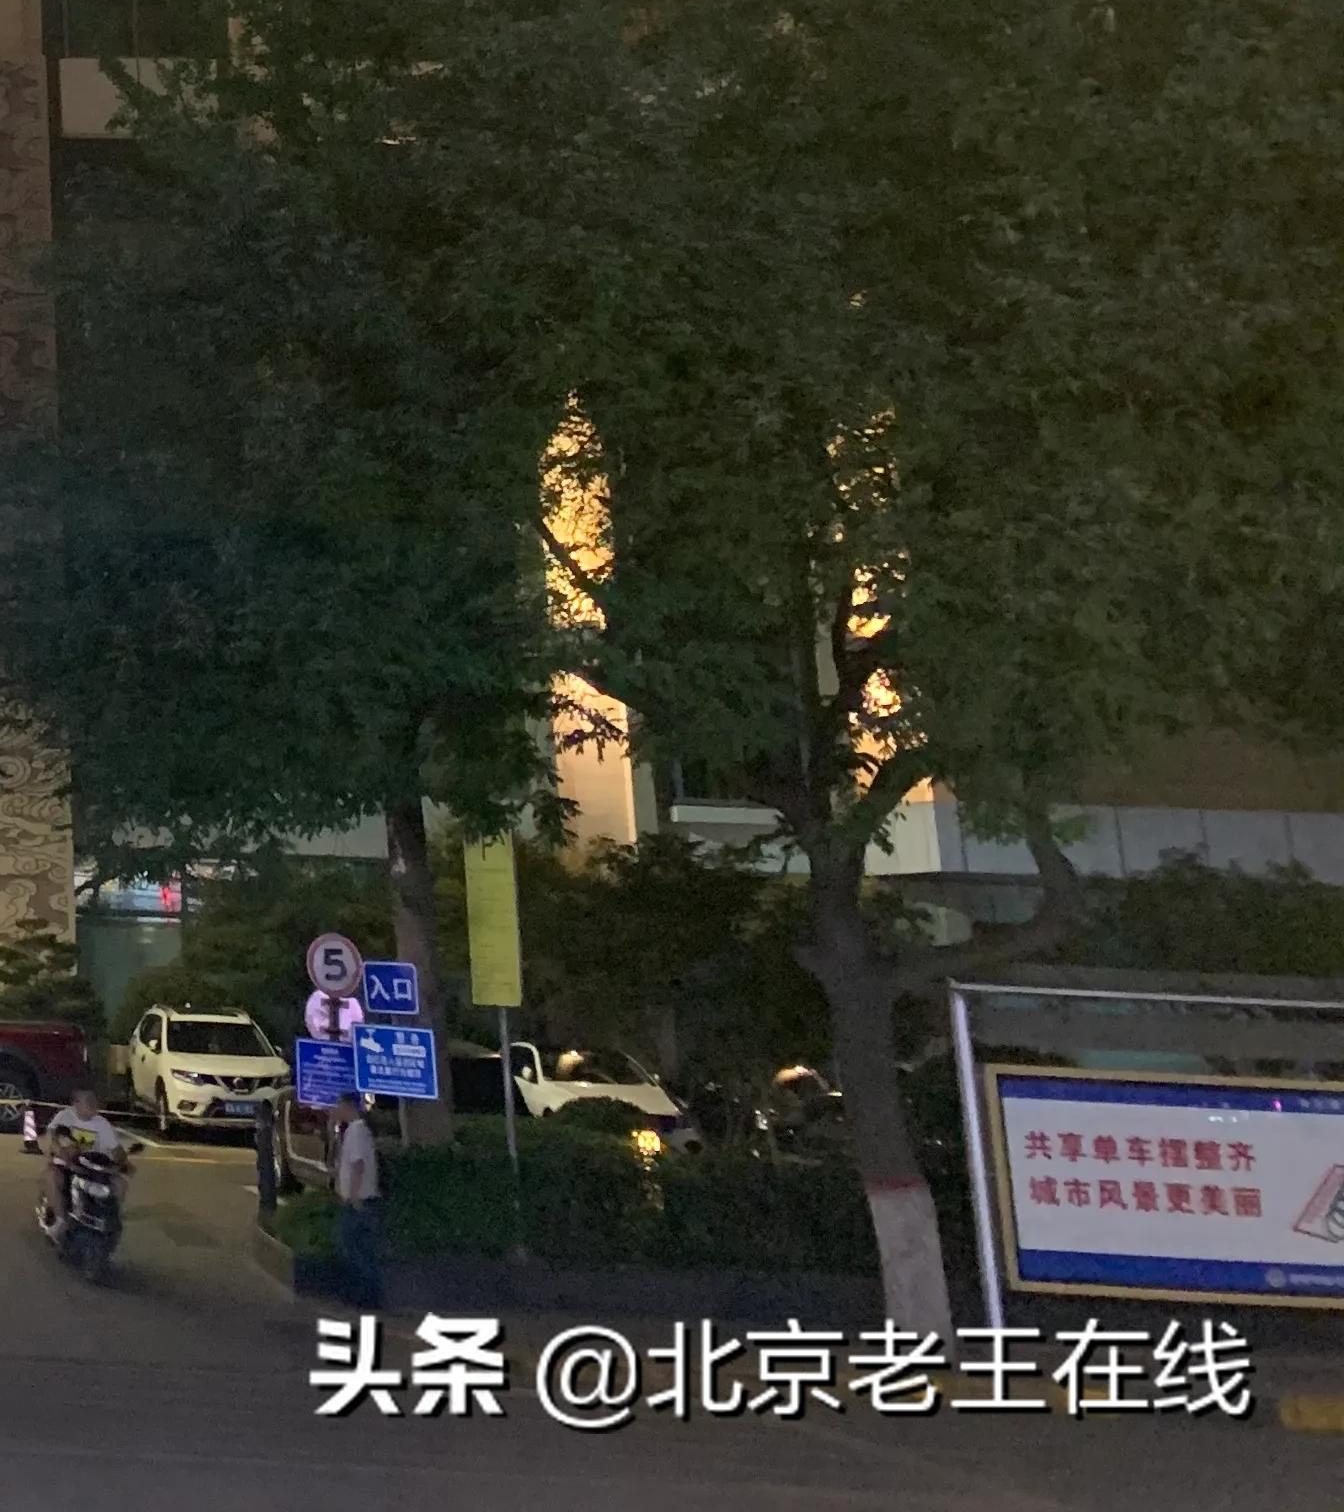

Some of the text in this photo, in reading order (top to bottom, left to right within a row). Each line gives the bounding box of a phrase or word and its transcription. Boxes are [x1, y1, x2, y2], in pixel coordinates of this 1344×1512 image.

[324, 948, 348, 981] 5
[370, 974, 413, 1001] 入口
[1024, 1130, 1256, 1172] 共享单车摆整齐
[1029, 1175, 1262, 1218] 城市风景更美丽
